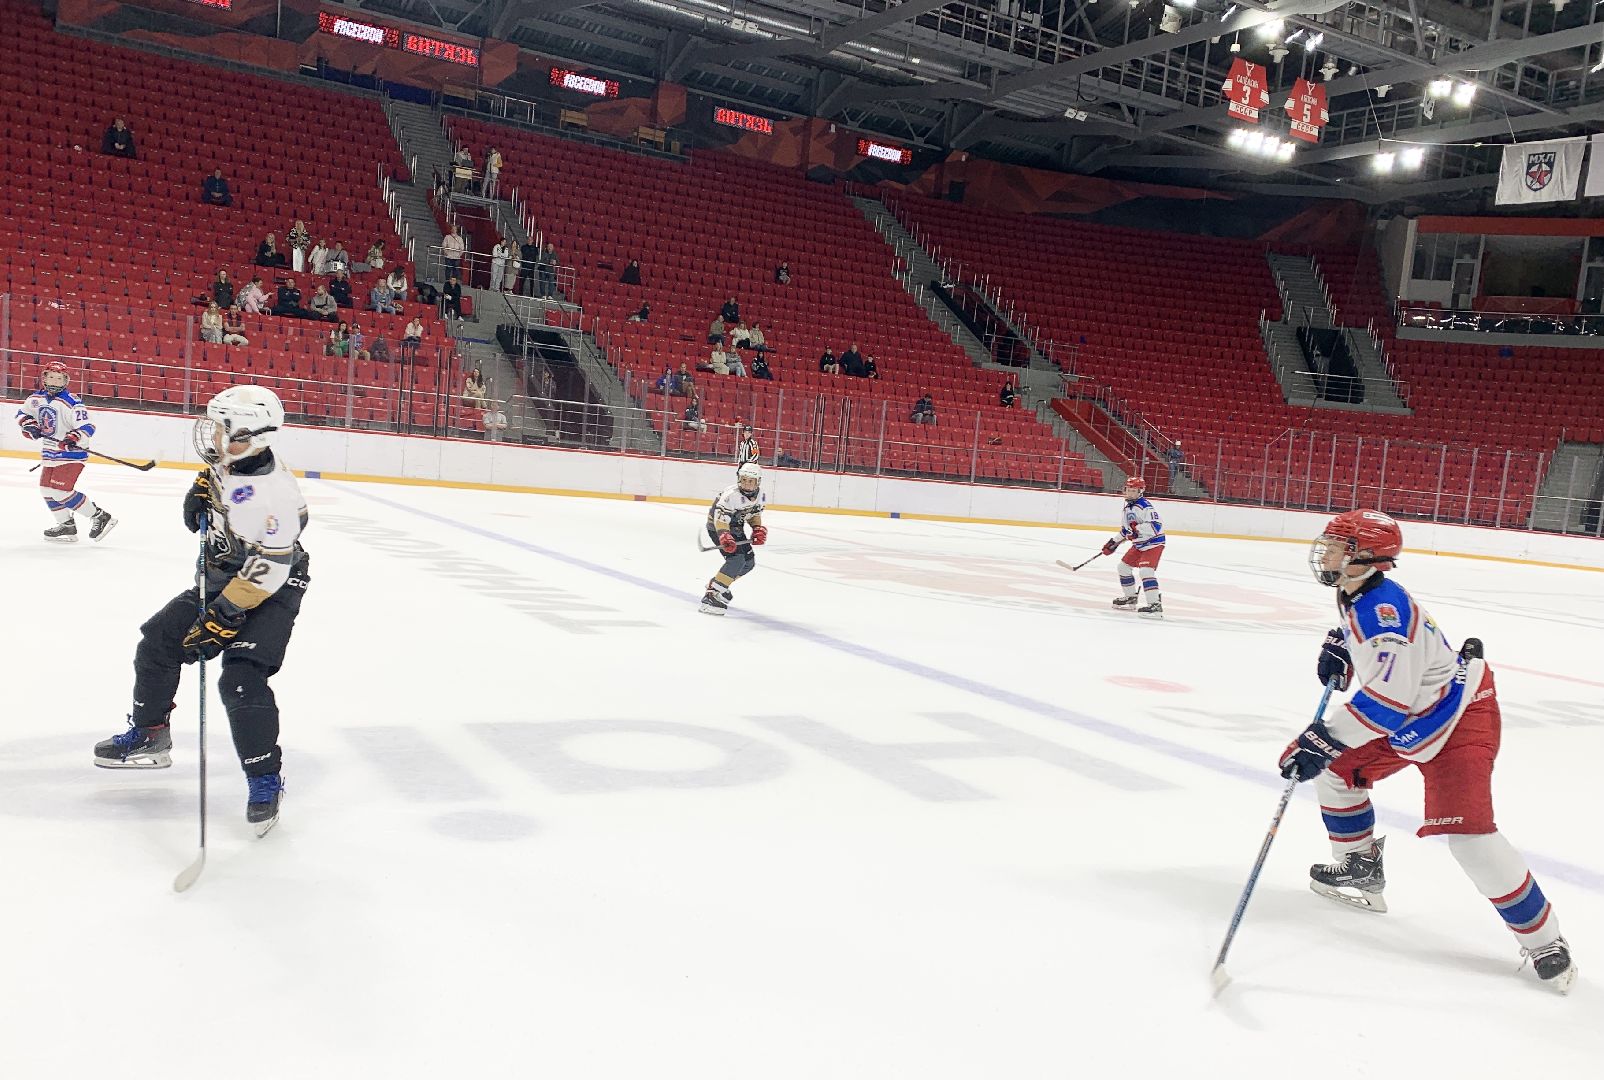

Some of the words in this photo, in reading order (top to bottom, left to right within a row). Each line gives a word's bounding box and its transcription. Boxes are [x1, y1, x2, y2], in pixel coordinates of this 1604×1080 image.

[1241, 85, 1251, 105] 3
[716, 108, 774, 134] ВИТЯЗЬ
[1302, 104, 1312, 123] 5
[1528, 153, 1555, 164] МХЛ
[75, 410, 88, 421] 28
[244, 752, 272, 765] CCM
